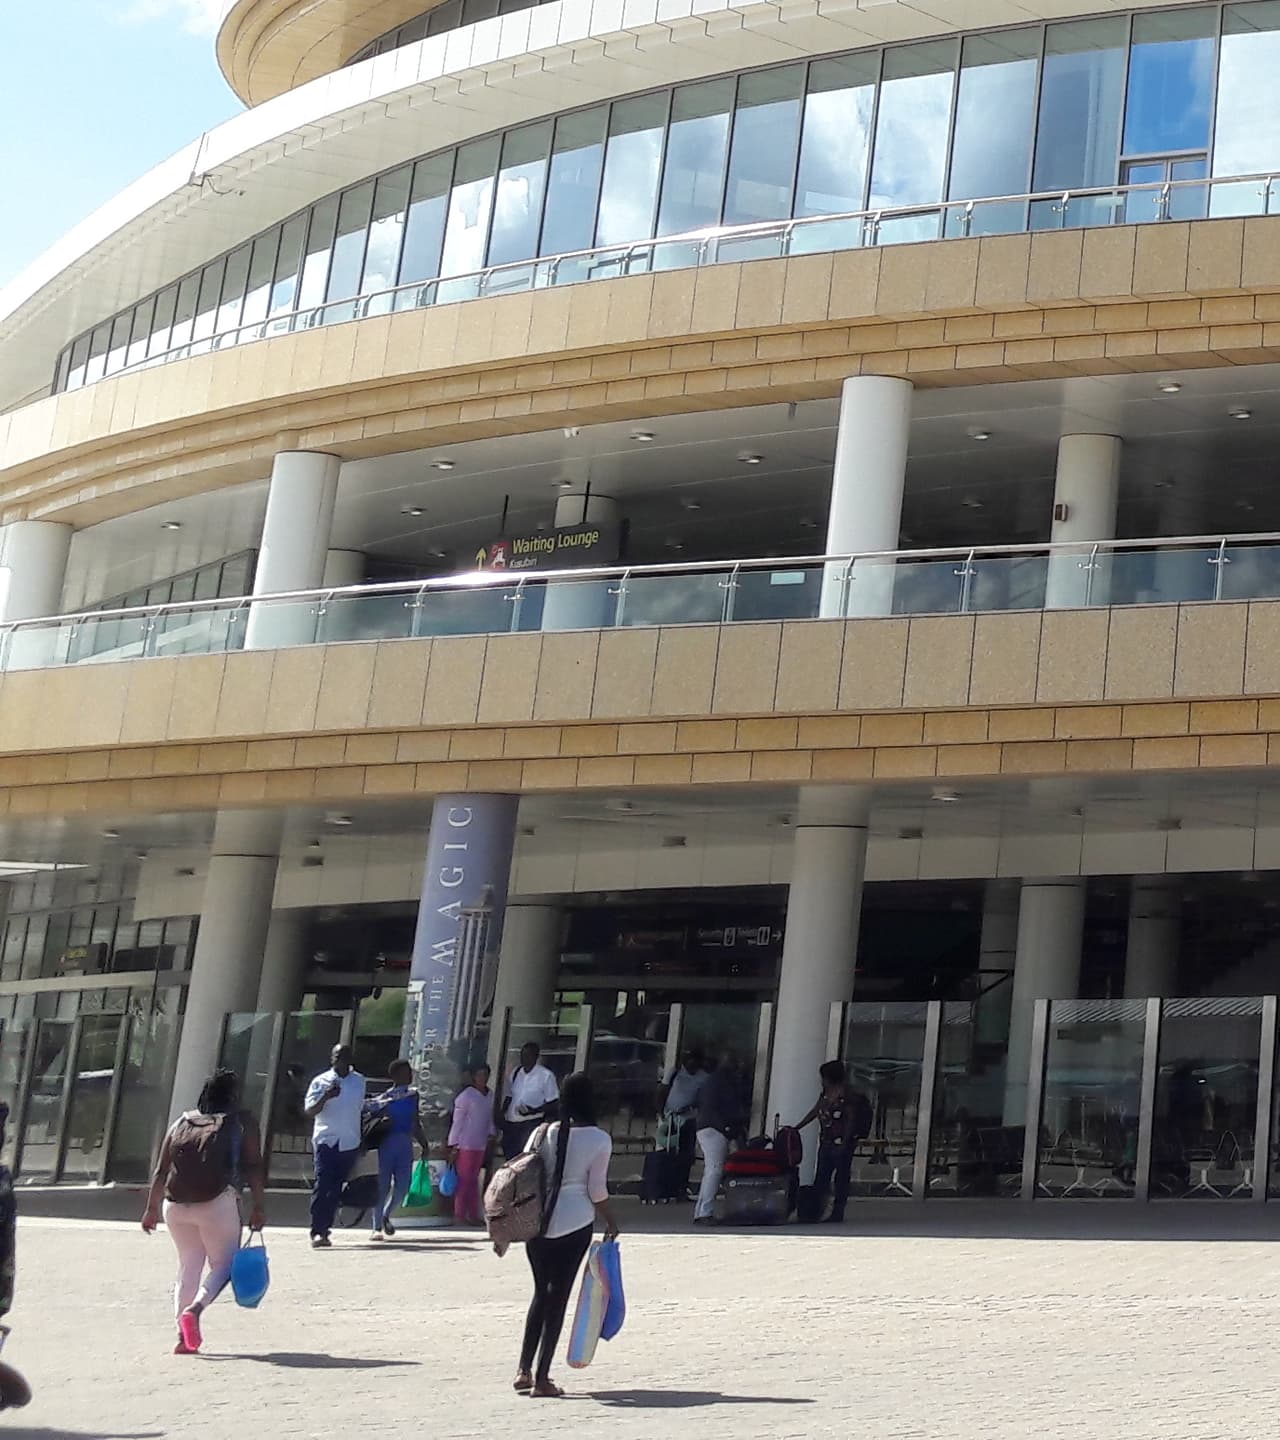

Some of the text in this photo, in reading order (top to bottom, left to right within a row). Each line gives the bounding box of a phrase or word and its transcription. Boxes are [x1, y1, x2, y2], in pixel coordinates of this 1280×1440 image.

[512, 530, 599, 553] Waiting Lounge
[431, 807, 473, 966] MAGIC
[428, 975, 445, 1015] THE
